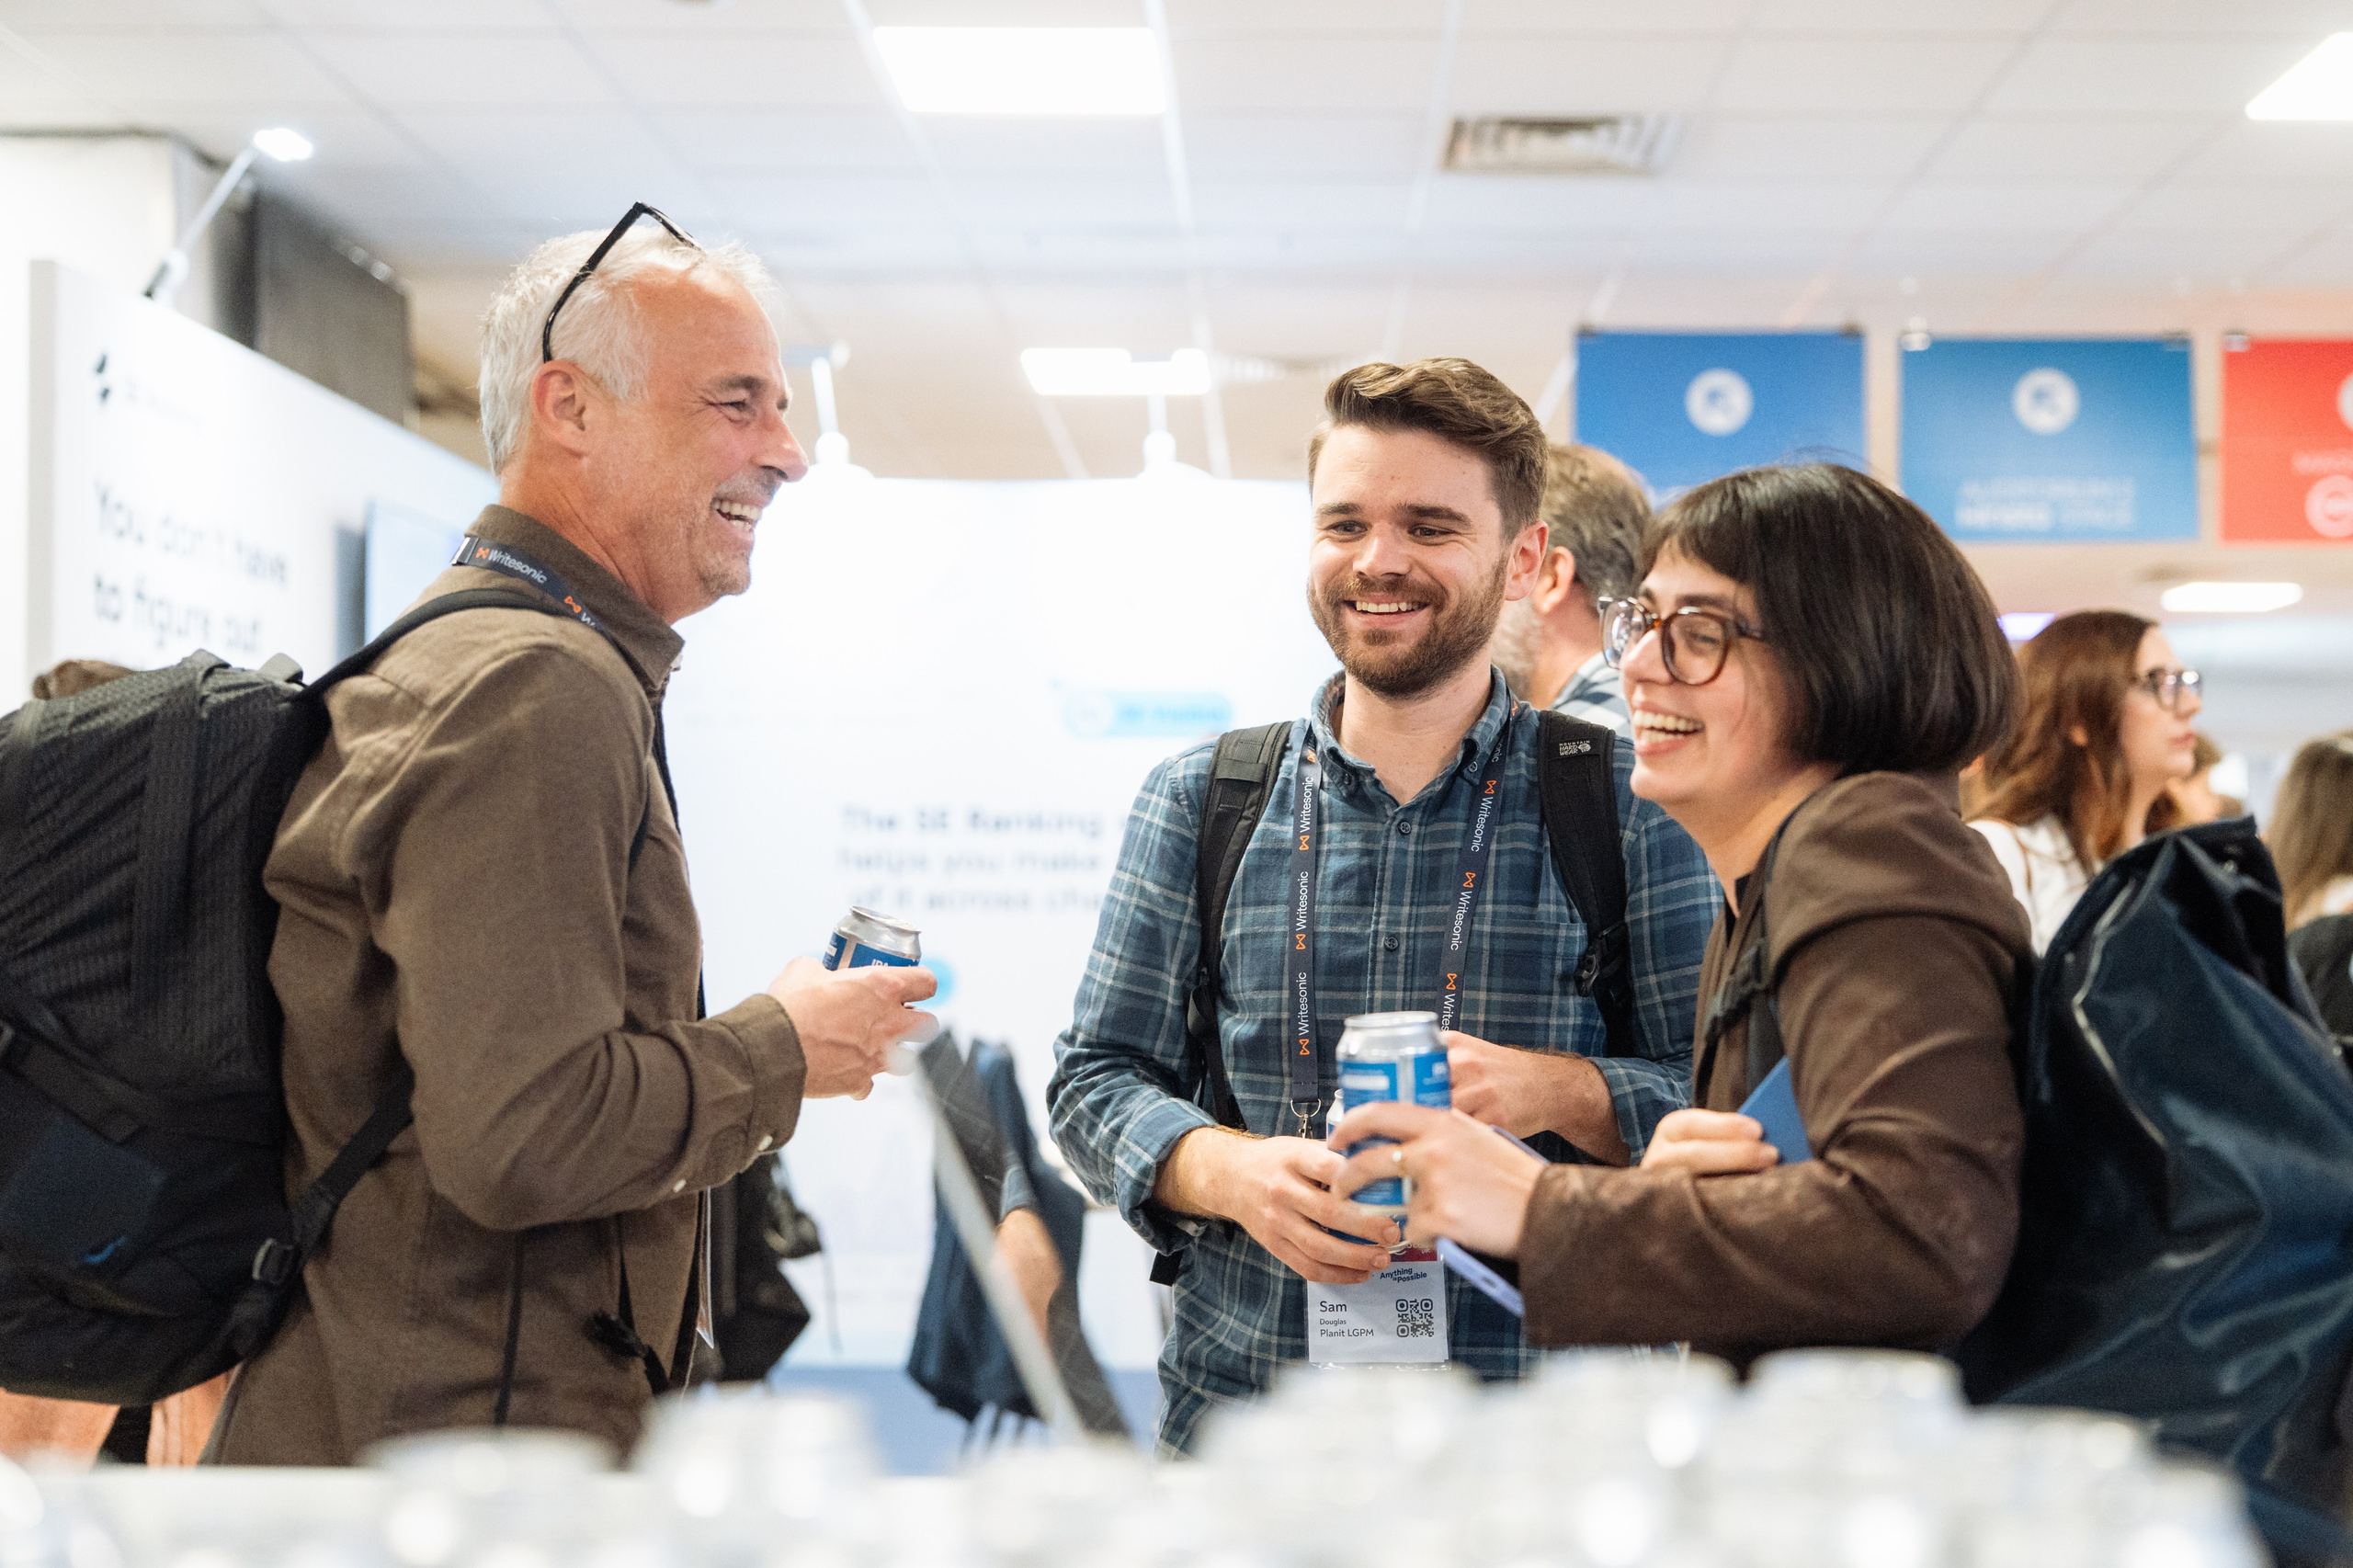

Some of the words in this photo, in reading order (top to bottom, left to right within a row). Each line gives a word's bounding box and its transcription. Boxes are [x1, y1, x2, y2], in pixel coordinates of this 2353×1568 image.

[488, 549, 547, 584] Writesonic
[1300, 776, 1313, 834] Writesonic
[1471, 797, 1494, 853] Writesonic
[1296, 871, 1309, 932] Writesonic
[1450, 891, 1472, 951] Writesonic
[1296, 971, 1309, 1036] Writesonic
[1440, 994, 1456, 1031] Writes
[1380, 1267, 1413, 1279] Anything
[1397, 1271, 1427, 1283] Possible
[1319, 1301, 1347, 1312] Sam
[1319, 1318, 1347, 1326] Douglas
[1320, 1328, 1346, 1337] Planit
[1347, 1328, 1374, 1337] LGPM
